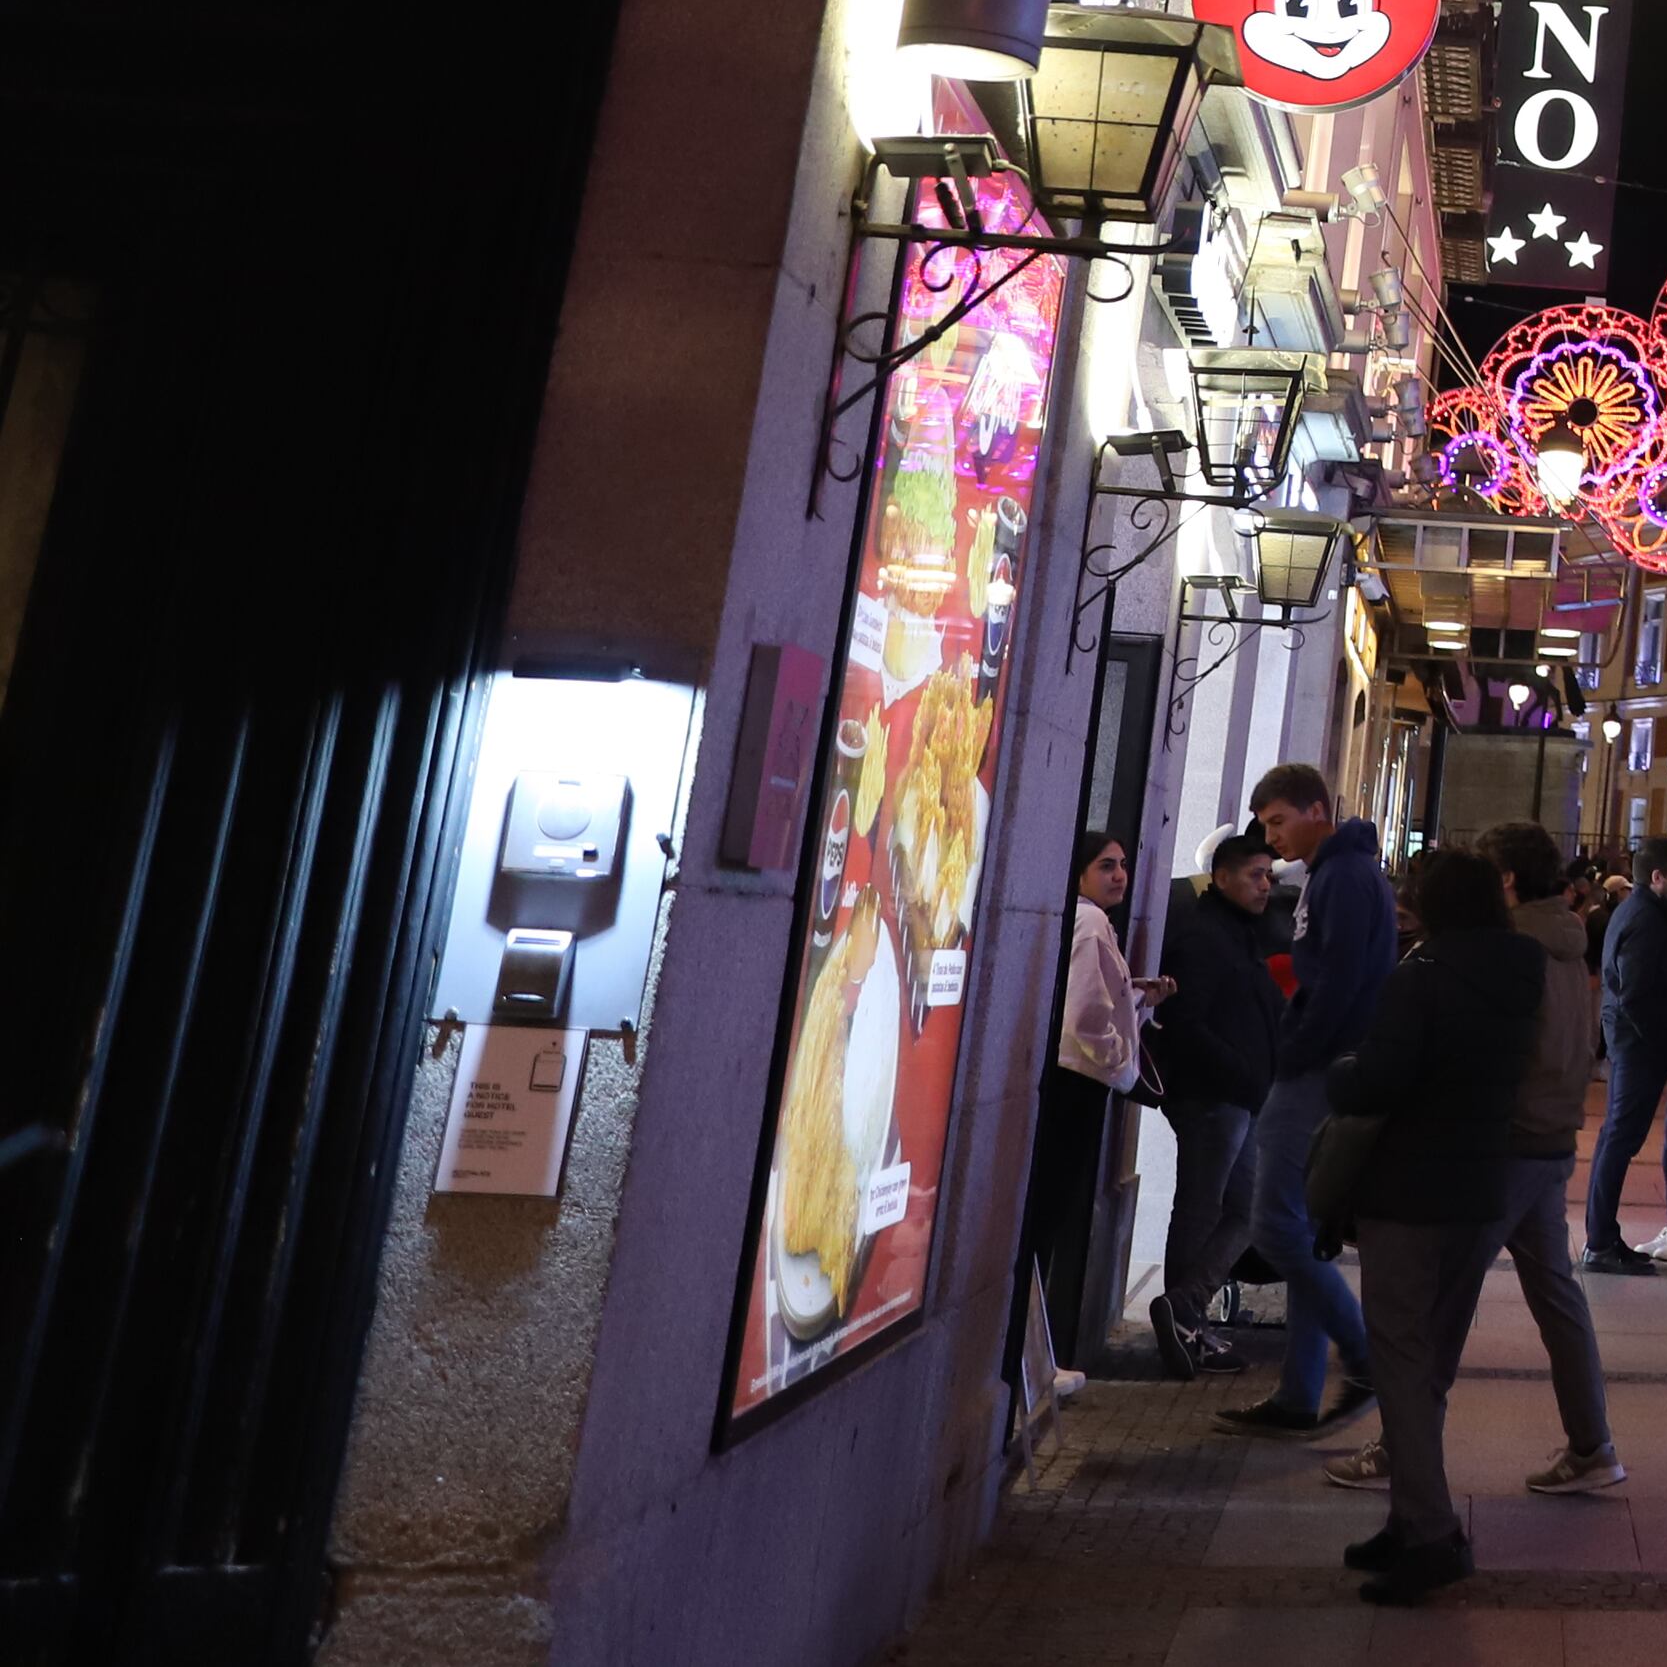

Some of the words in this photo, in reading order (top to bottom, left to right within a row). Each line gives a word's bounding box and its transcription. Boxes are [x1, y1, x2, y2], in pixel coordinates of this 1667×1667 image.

[826, 838, 845, 867] PEPSI
[471, 1082, 491, 1090] THIS
[476, 1092, 510, 1101] NOTICE
[465, 1101, 486, 1110] FOR
[487, 1102, 517, 1111] HOTEL
[463, 1110, 495, 1119] GUEST
